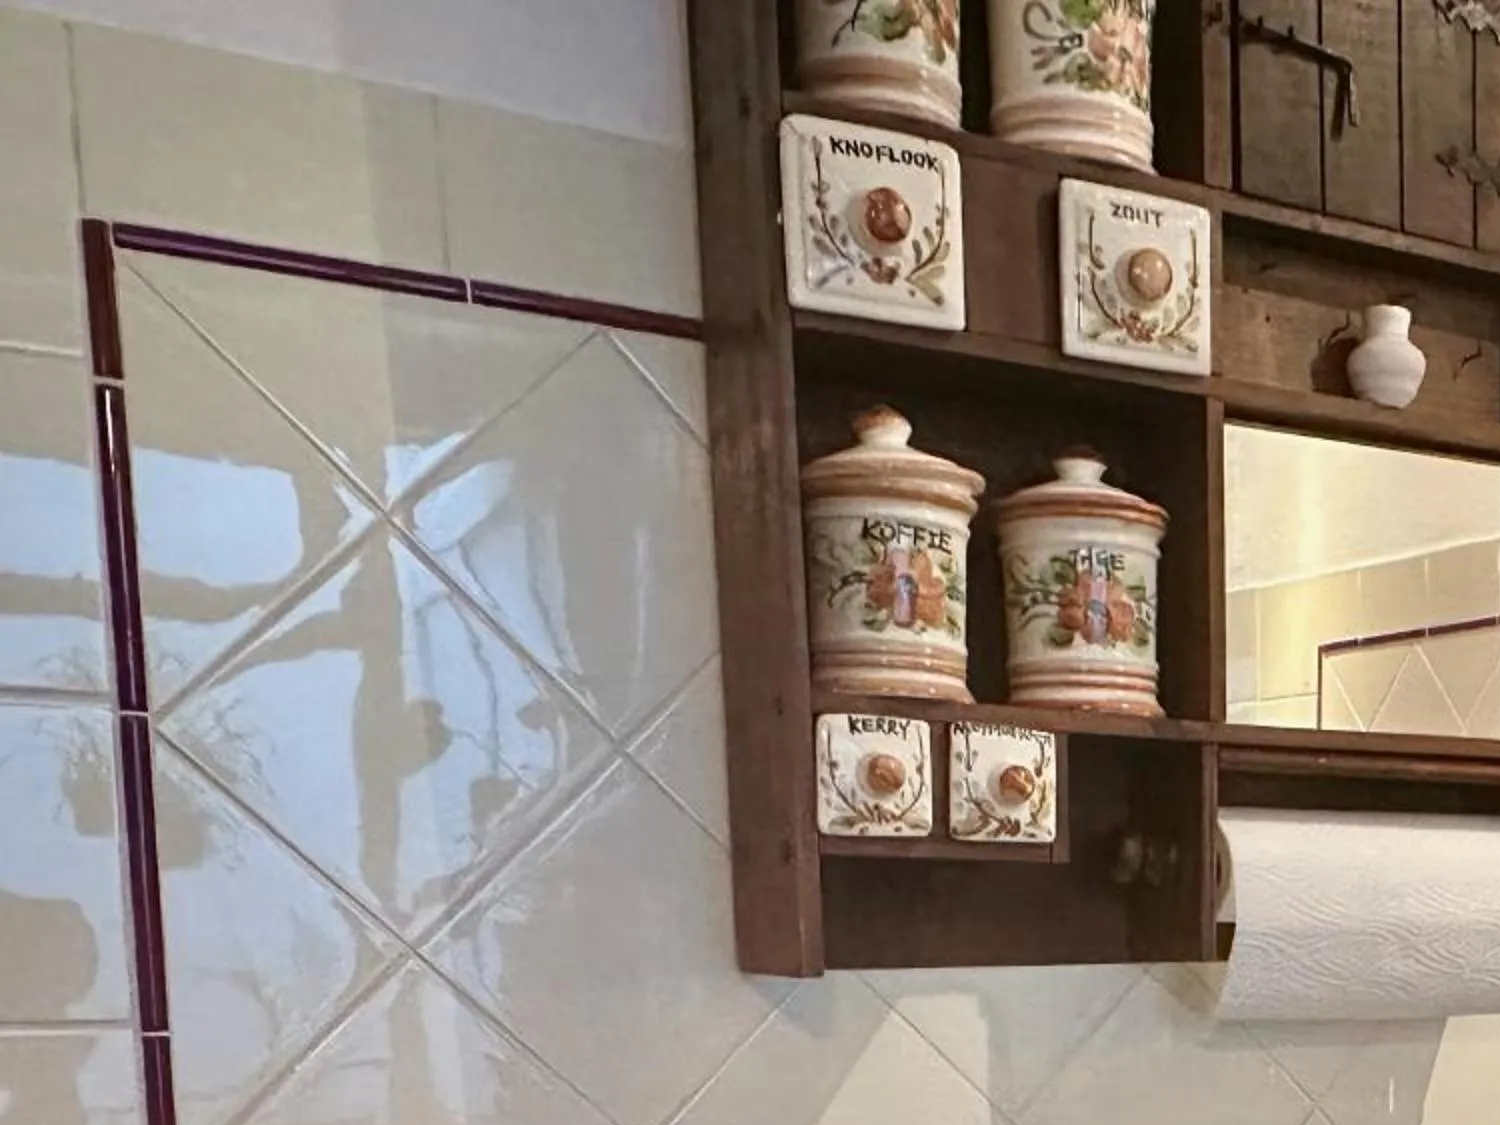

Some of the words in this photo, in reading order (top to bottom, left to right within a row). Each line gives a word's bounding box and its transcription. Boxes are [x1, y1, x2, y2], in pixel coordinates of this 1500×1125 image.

[829, 135, 938, 173] KNOFLOOK
[861, 517, 952, 554] KOFFIE
[847, 715, 910, 741] KERRY
